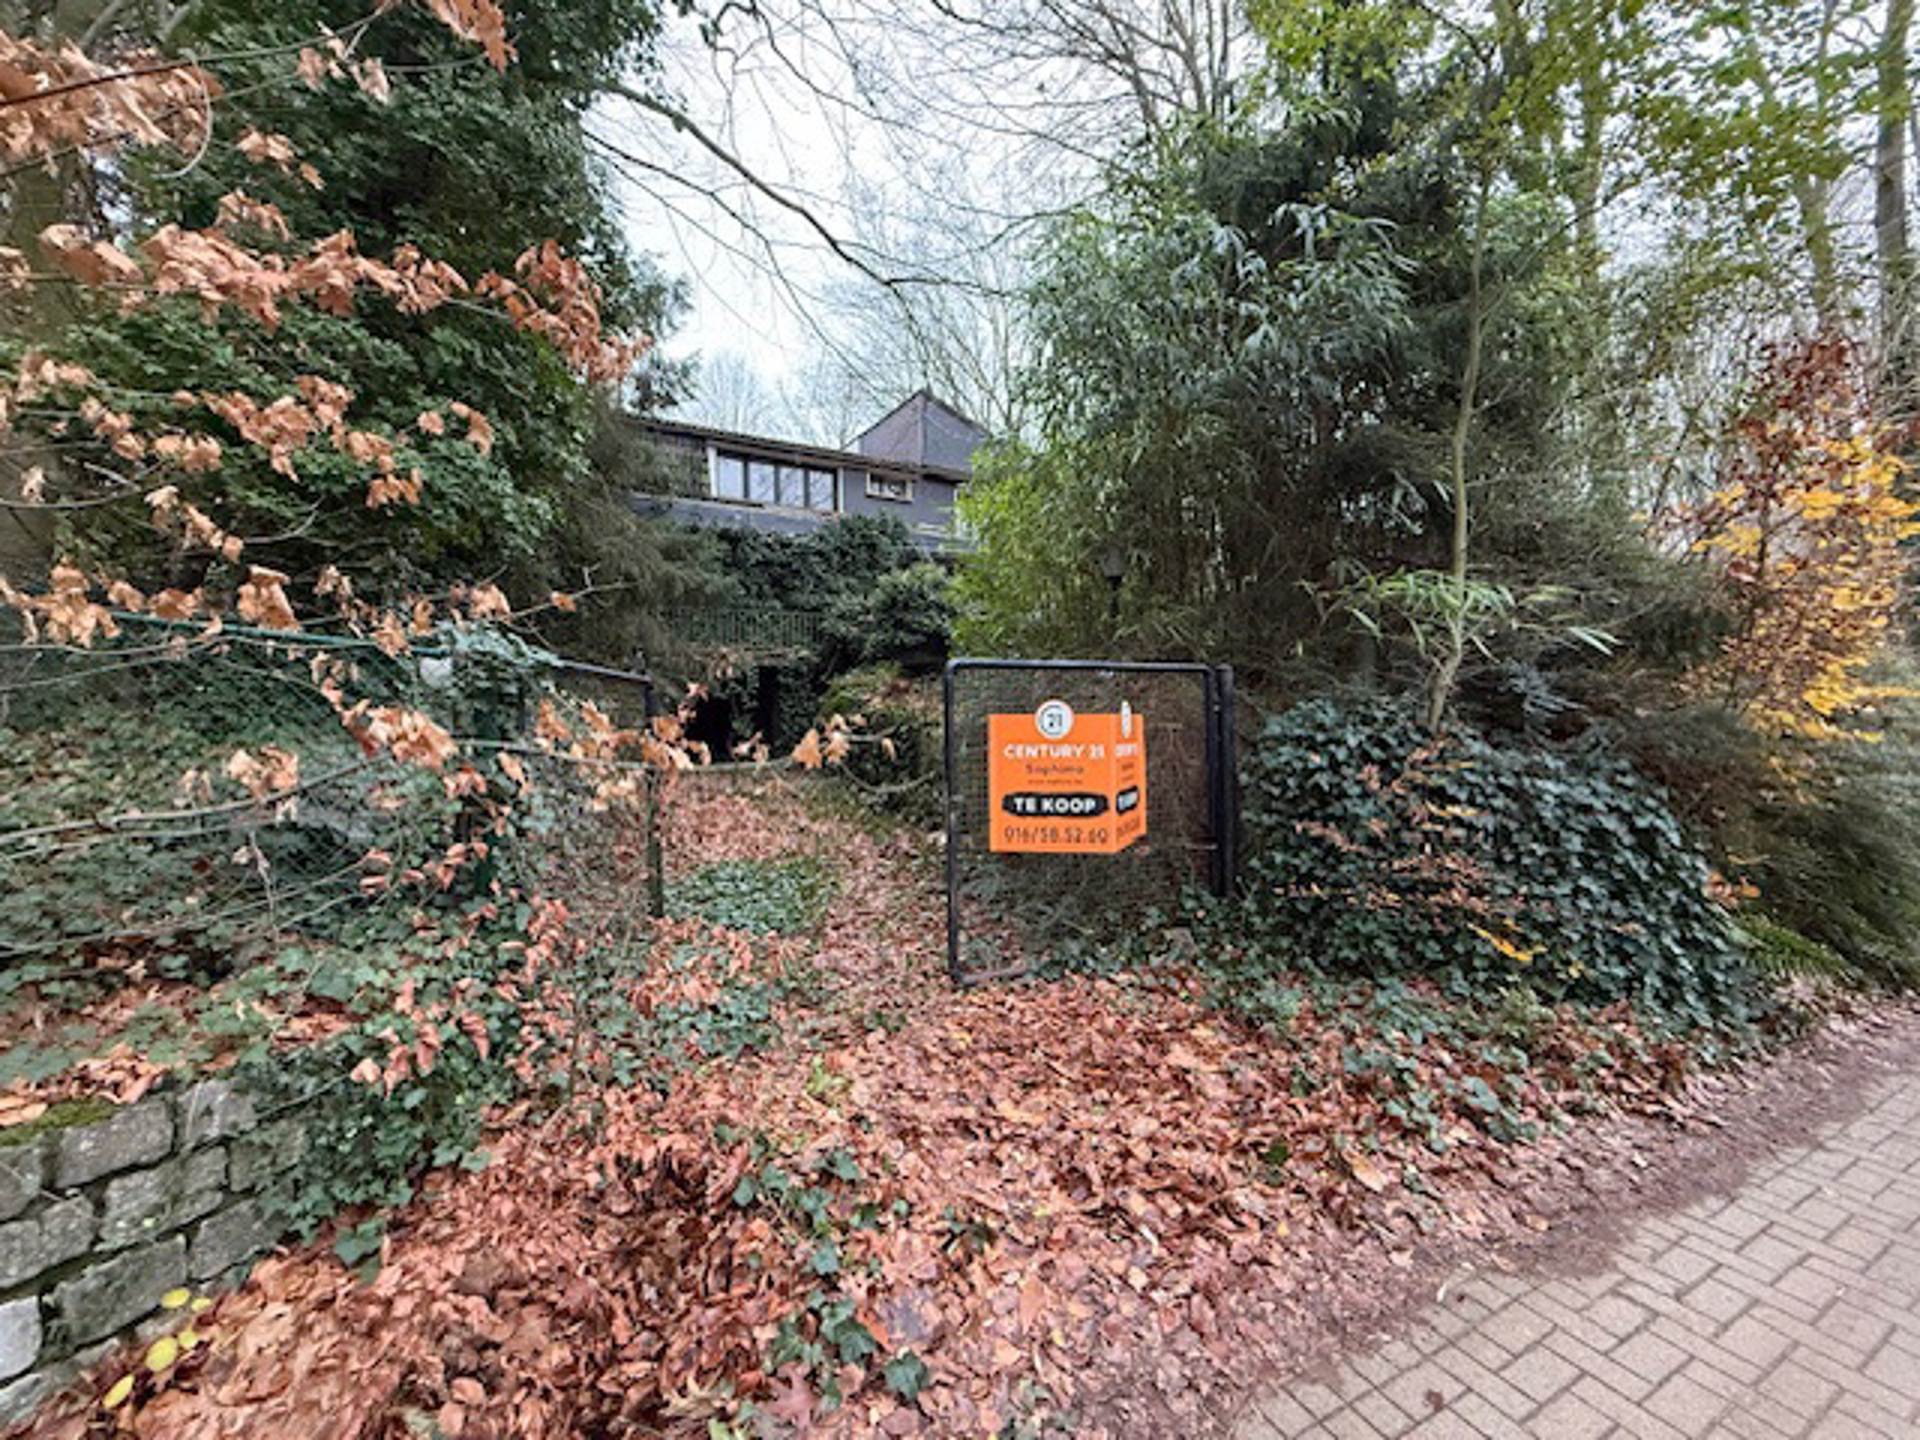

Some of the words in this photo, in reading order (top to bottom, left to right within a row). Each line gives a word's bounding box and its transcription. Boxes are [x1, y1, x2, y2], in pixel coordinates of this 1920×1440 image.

[1004, 743, 1085, 758] CENTURY
[1089, 743, 1106, 758] 21
[1014, 797, 1036, 813] TE
[1041, 797, 1097, 813] KOOP
